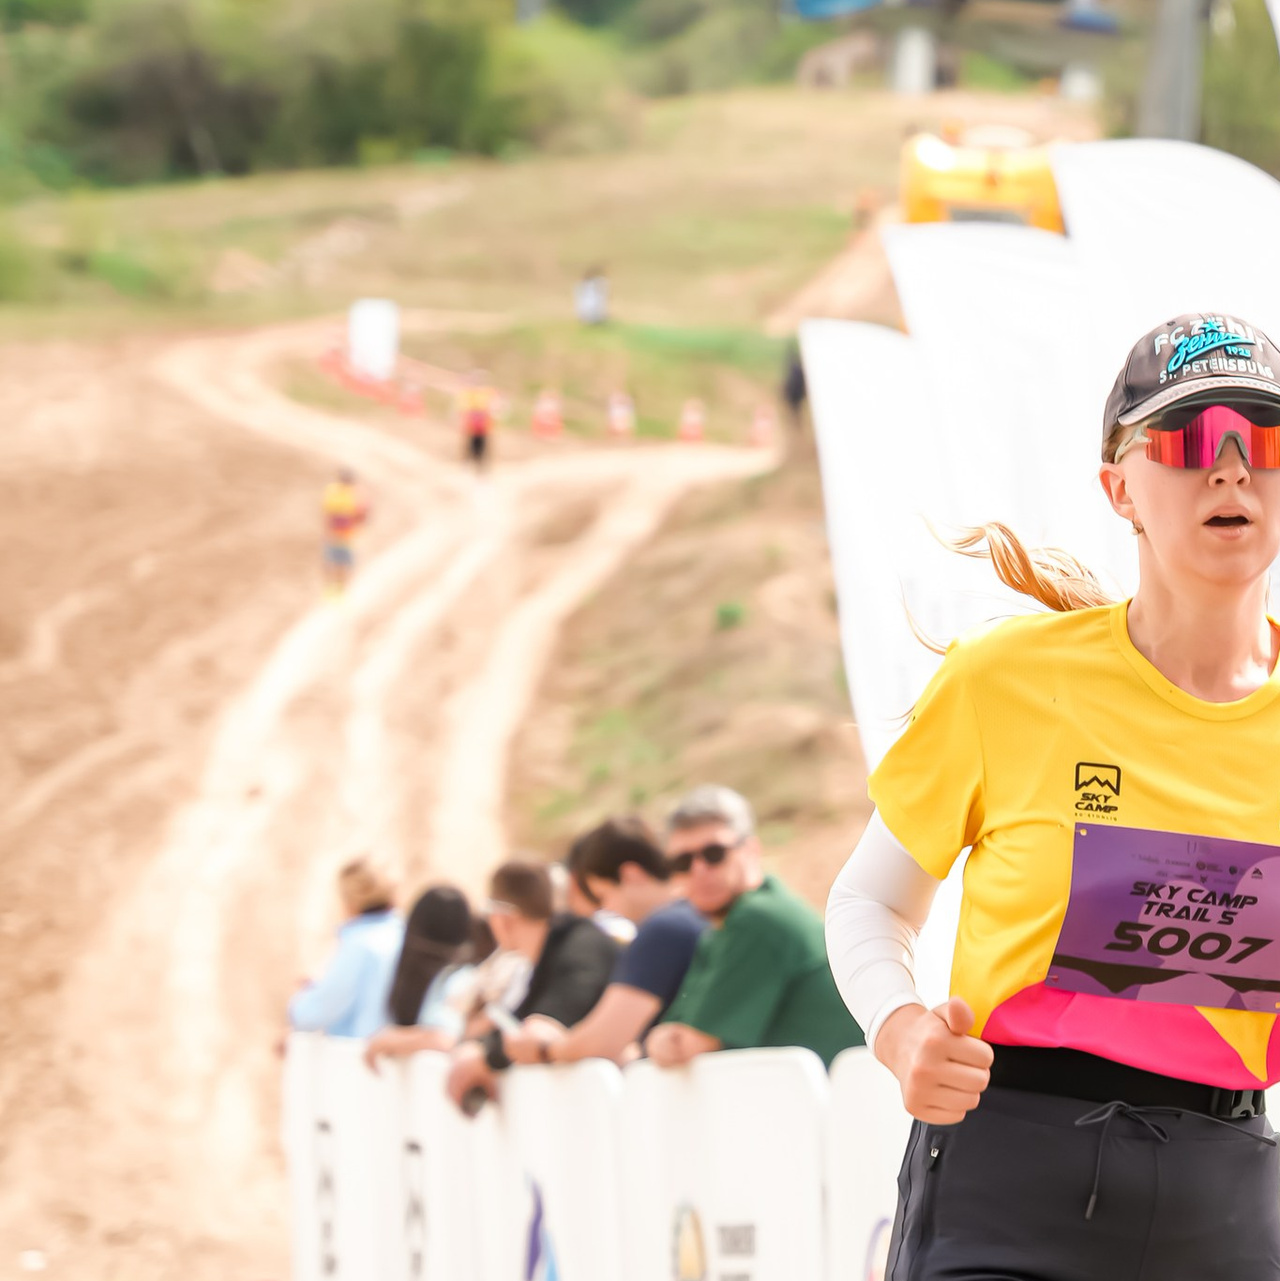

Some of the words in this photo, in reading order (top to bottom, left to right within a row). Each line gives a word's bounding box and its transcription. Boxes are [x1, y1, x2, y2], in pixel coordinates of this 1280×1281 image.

[1154, 326, 1186, 356] FC
[1075, 801, 1118, 814] CAMP
[1081, 792, 1113, 803] SKY
[1130, 880, 1183, 900] SKY
[1187, 888, 1259, 910] CAMP
[1143, 900, 1212, 923] TRAIL
[1103, 921, 1275, 965] 5007
